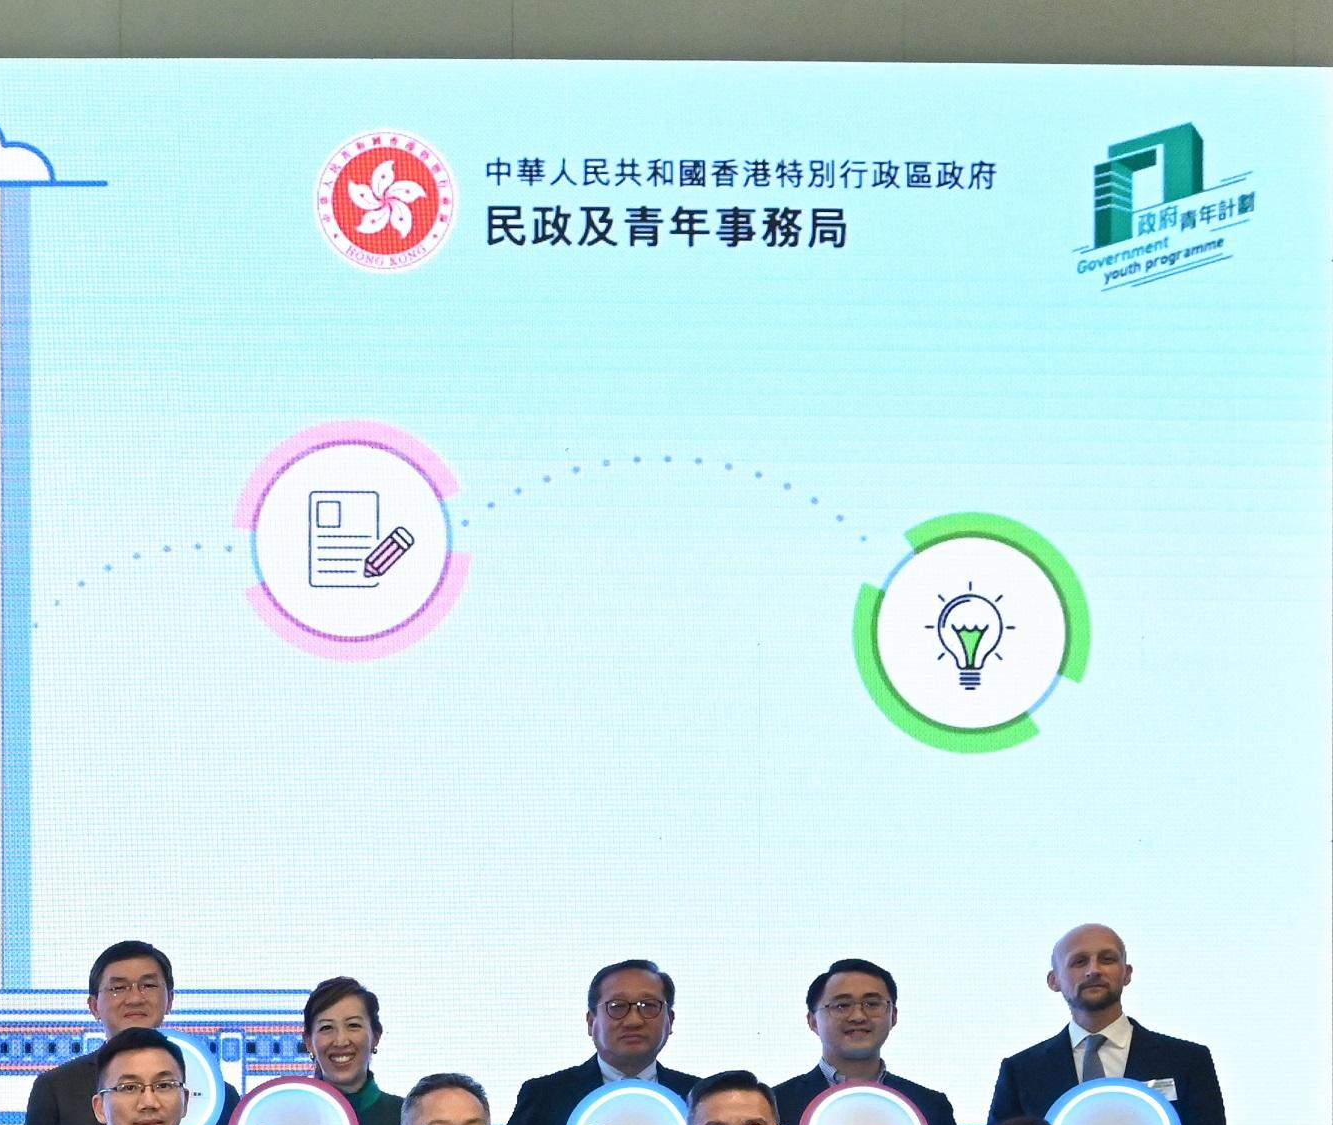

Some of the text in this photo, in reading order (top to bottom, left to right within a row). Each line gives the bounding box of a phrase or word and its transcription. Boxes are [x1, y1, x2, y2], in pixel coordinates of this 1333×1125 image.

[486, 157, 998, 189] 中華人民共和國香港特別行政區政府
[486, 205, 848, 248] 民政及青年事務局
[1137, 191, 1255, 237] 政府青年計劃
[345, 244, 427, 266] HONG KONG
[1076, 236, 1169, 274] Government
[1104, 237, 1224, 284] youth programme
